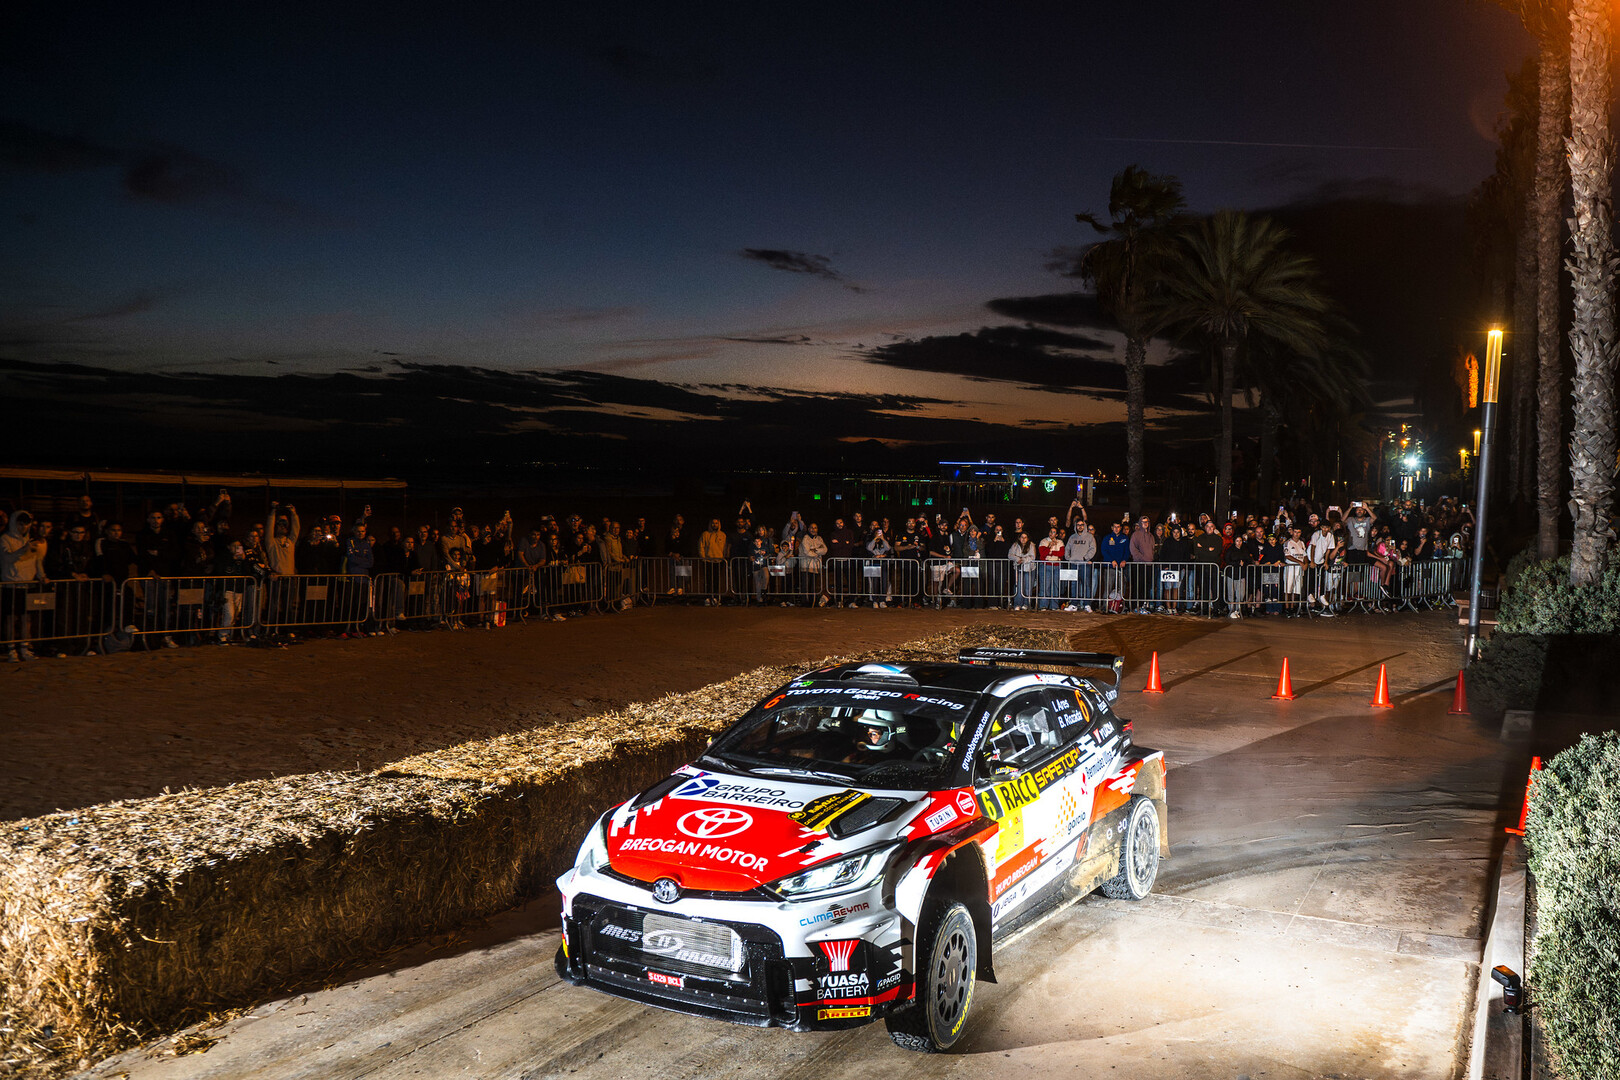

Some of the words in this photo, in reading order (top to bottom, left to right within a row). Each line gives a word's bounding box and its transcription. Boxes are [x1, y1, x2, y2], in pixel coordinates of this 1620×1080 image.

[764, 694, 787, 710] 6
[786, 688, 842, 696] TOYOTA
[844, 688, 903, 698] GAZOO
[903, 692, 966, 710] Racing
[1074, 689, 1090, 723] 6
[961, 711, 991, 771] grupobreogan.com
[1034, 747, 1080, 789] SAFETOP
[701, 790, 805, 809] BARREIRO
[714, 783, 786, 797] GRUPO
[999, 774, 1037, 811] RACC
[980, 790, 998, 821] 6
[929, 809, 955, 829] TURINI
[619, 838, 702, 857] BREOGAN
[699, 842, 769, 872] MOTOR
[800, 902, 870, 926] CLIMAREYMA
[817, 972, 869, 988] YUASA
[883, 972, 901, 985] PAGID
[817, 985, 869, 1000] BATTERY
